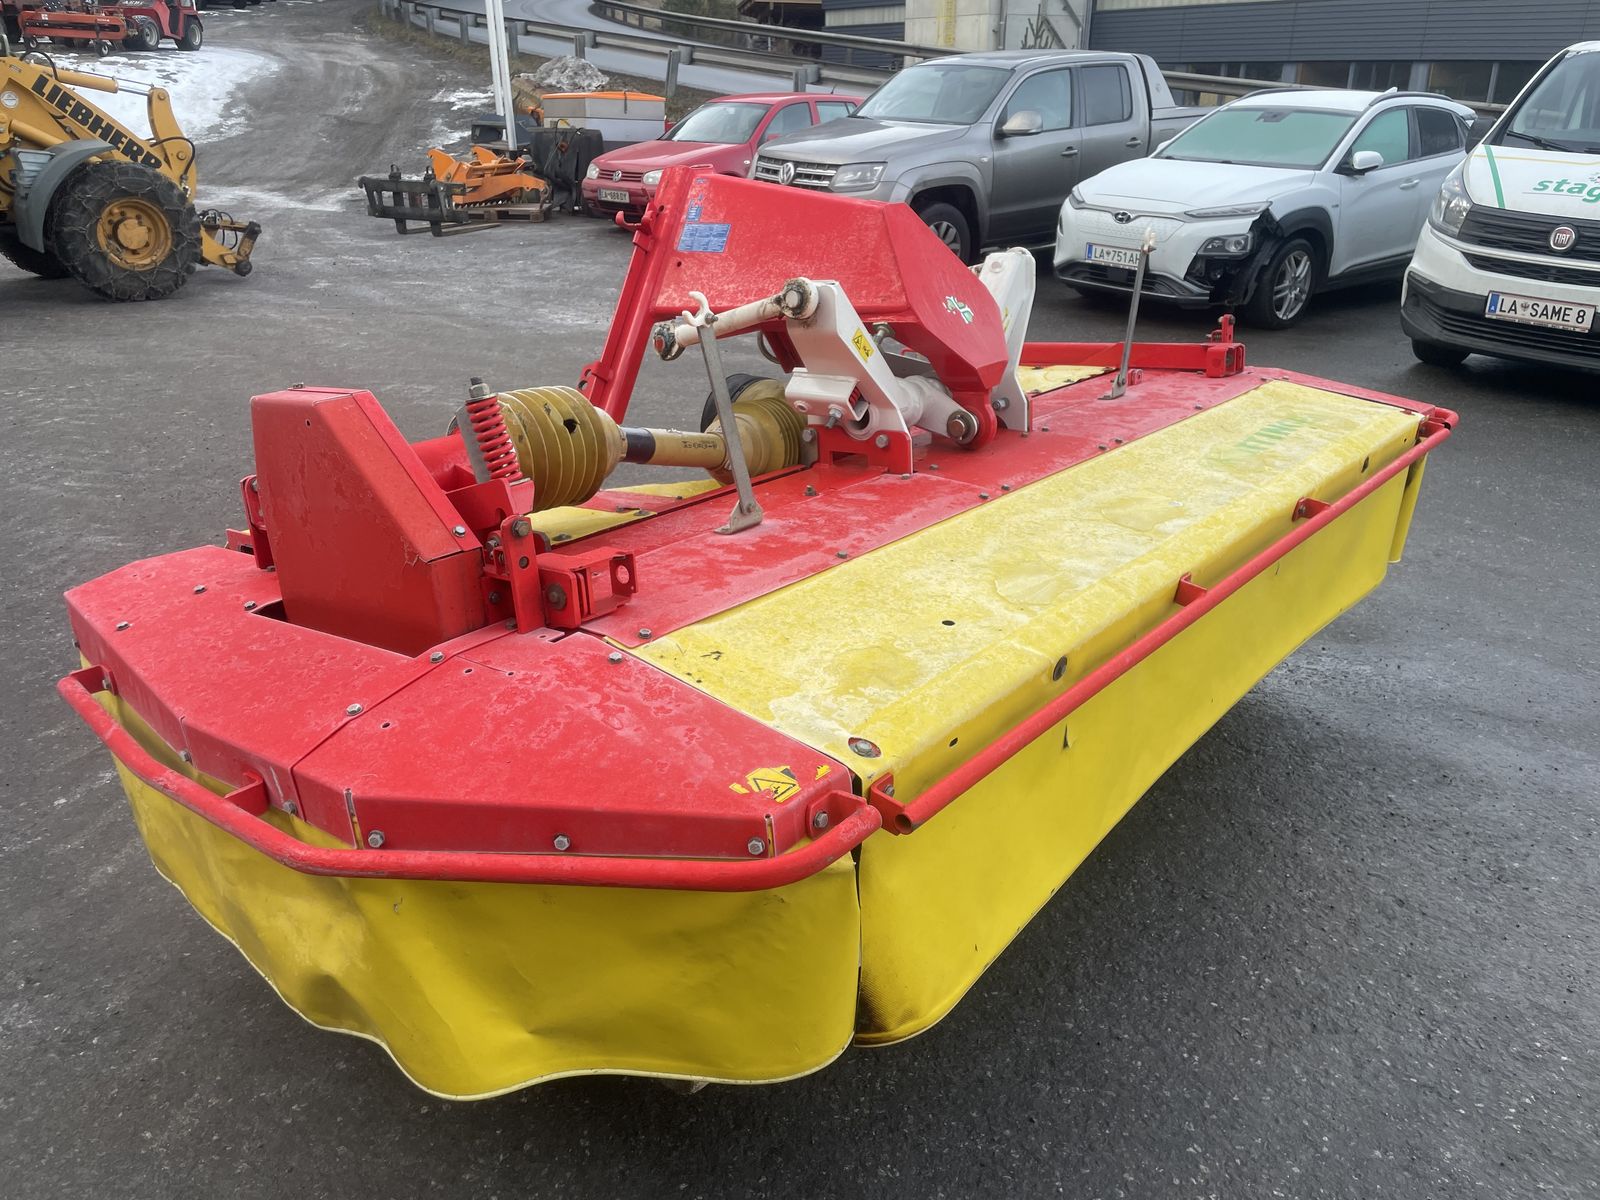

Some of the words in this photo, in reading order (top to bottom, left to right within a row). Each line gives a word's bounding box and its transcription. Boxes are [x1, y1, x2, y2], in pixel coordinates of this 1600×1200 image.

[31, 74, 163, 169] LIEBHERR
[1554, 232, 1571, 245] FIAT
[1095, 247, 1105, 259] LA
[1500, 299, 1518, 315] LA
[1529, 302, 1573, 322] SAME
[1575, 309, 1586, 324] 8
